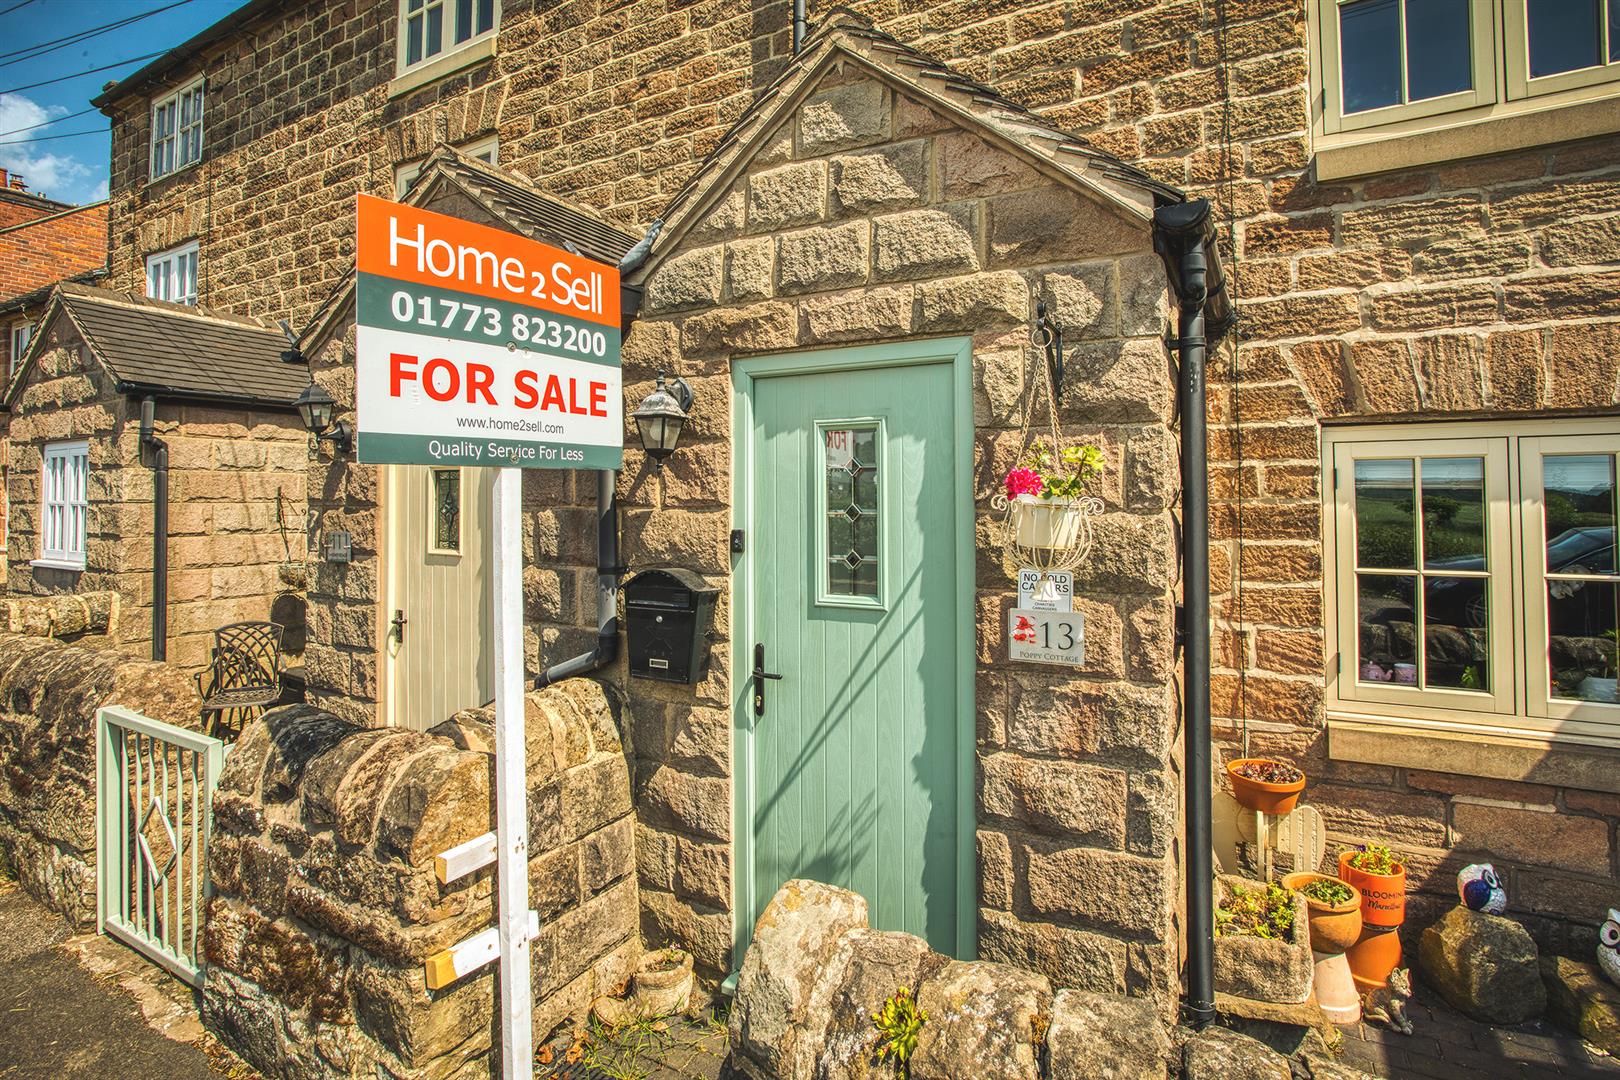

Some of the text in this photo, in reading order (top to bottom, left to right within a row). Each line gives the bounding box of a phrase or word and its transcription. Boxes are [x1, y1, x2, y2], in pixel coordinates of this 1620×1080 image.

[389, 216, 603, 315] Home 2 Sell
[391, 291, 606, 358] 01773 823200
[389, 353, 608, 418] FOR SALE
[456, 416, 564, 434] www.home2sell.com
[429, 440, 584, 461] Quality Service For Less
[1021, 582, 1069, 593] CARS
[1024, 573, 1038, 582] NO
[1040, 621, 1074, 650] 13
[1020, 651, 1079, 662] POPPY COTTAGE
